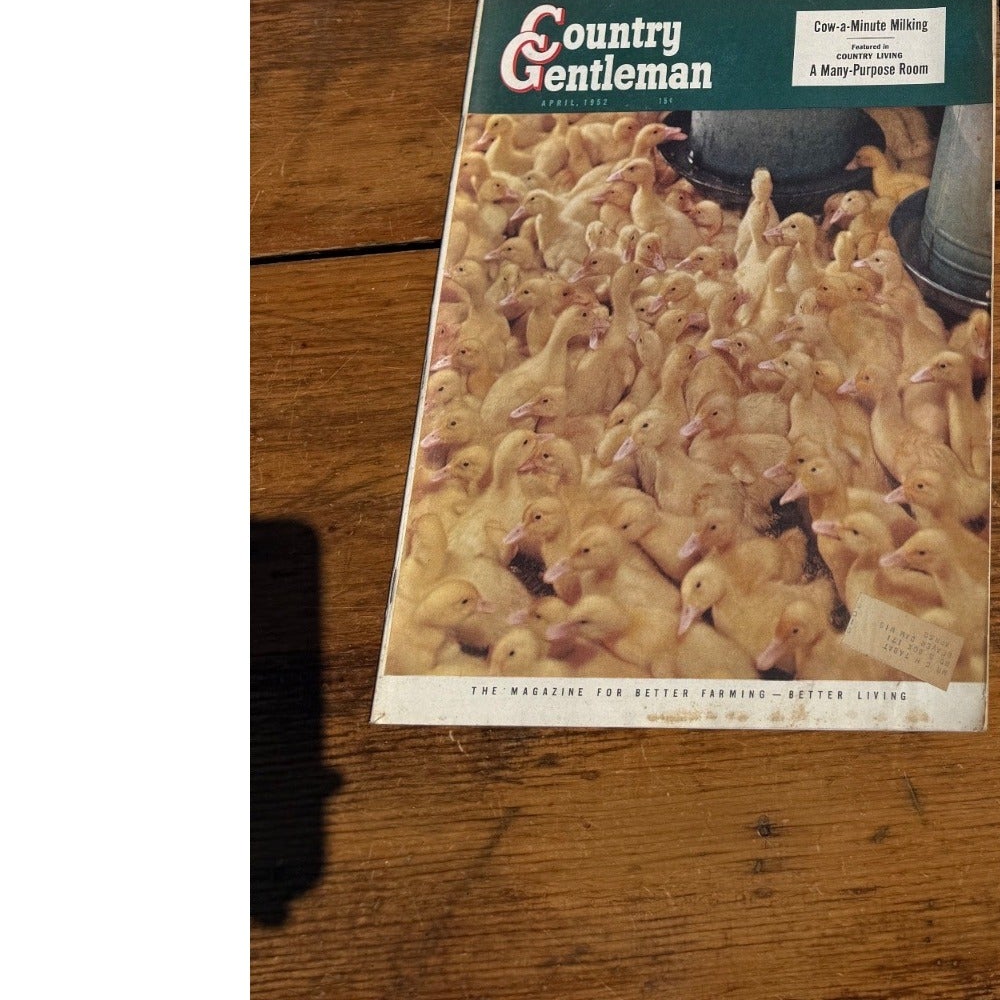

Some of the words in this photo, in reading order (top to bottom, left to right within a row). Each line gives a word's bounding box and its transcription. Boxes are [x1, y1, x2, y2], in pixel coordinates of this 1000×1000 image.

[814, 19, 887, 33] Cow-a-Minute
[890, 18, 929, 33] Milking
[520, 4, 682, 64] Country
[500, 31, 713, 94] Gentleman
[810, 64, 817, 77] A
[821, 64, 896, 78] Many-Purpose
[899, 63, 928, 75] Room
[541, 99, 579, 107] APRIL,
[471, 687, 498, 696] THE
[511, 687, 585, 697] MAGAZINE
[597, 688, 623, 698] FOR
[635, 688, 690, 698] BETTER
[701, 689, 766, 699] FARMING
[789, 690, 844, 700] BETTER
[858, 691, 908, 701] LIVING
